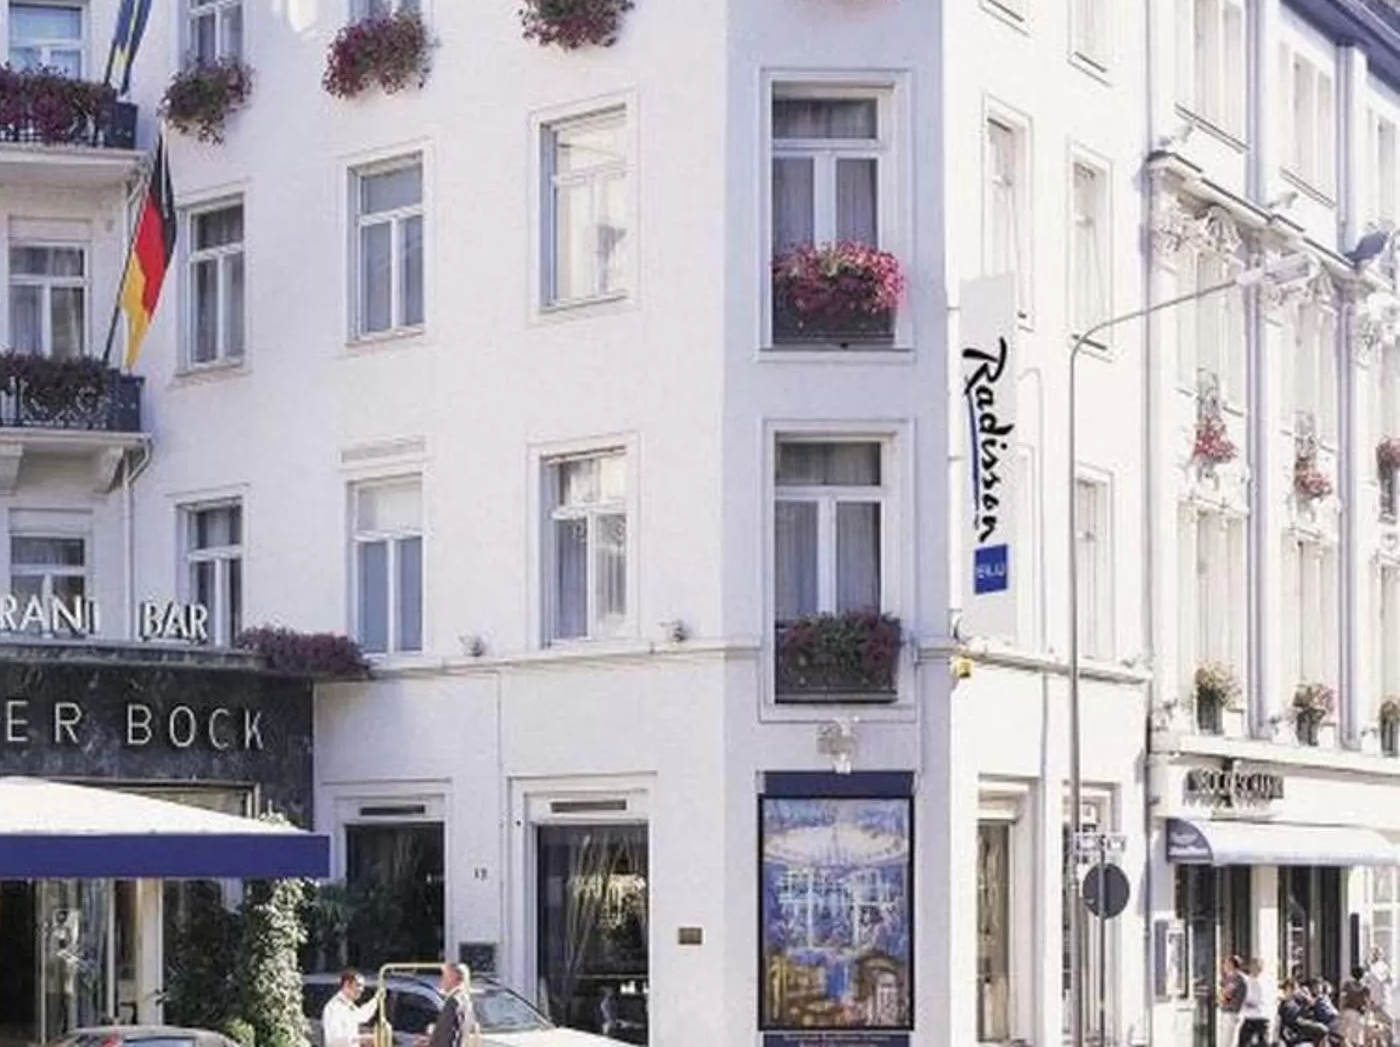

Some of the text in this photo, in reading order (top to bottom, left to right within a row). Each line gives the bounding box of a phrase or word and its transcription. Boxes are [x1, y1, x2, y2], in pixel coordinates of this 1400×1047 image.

[962, 337, 1015, 543] Radisson
[139, 600, 209, 642] BAR
[126, 703, 264, 751] BOCK
